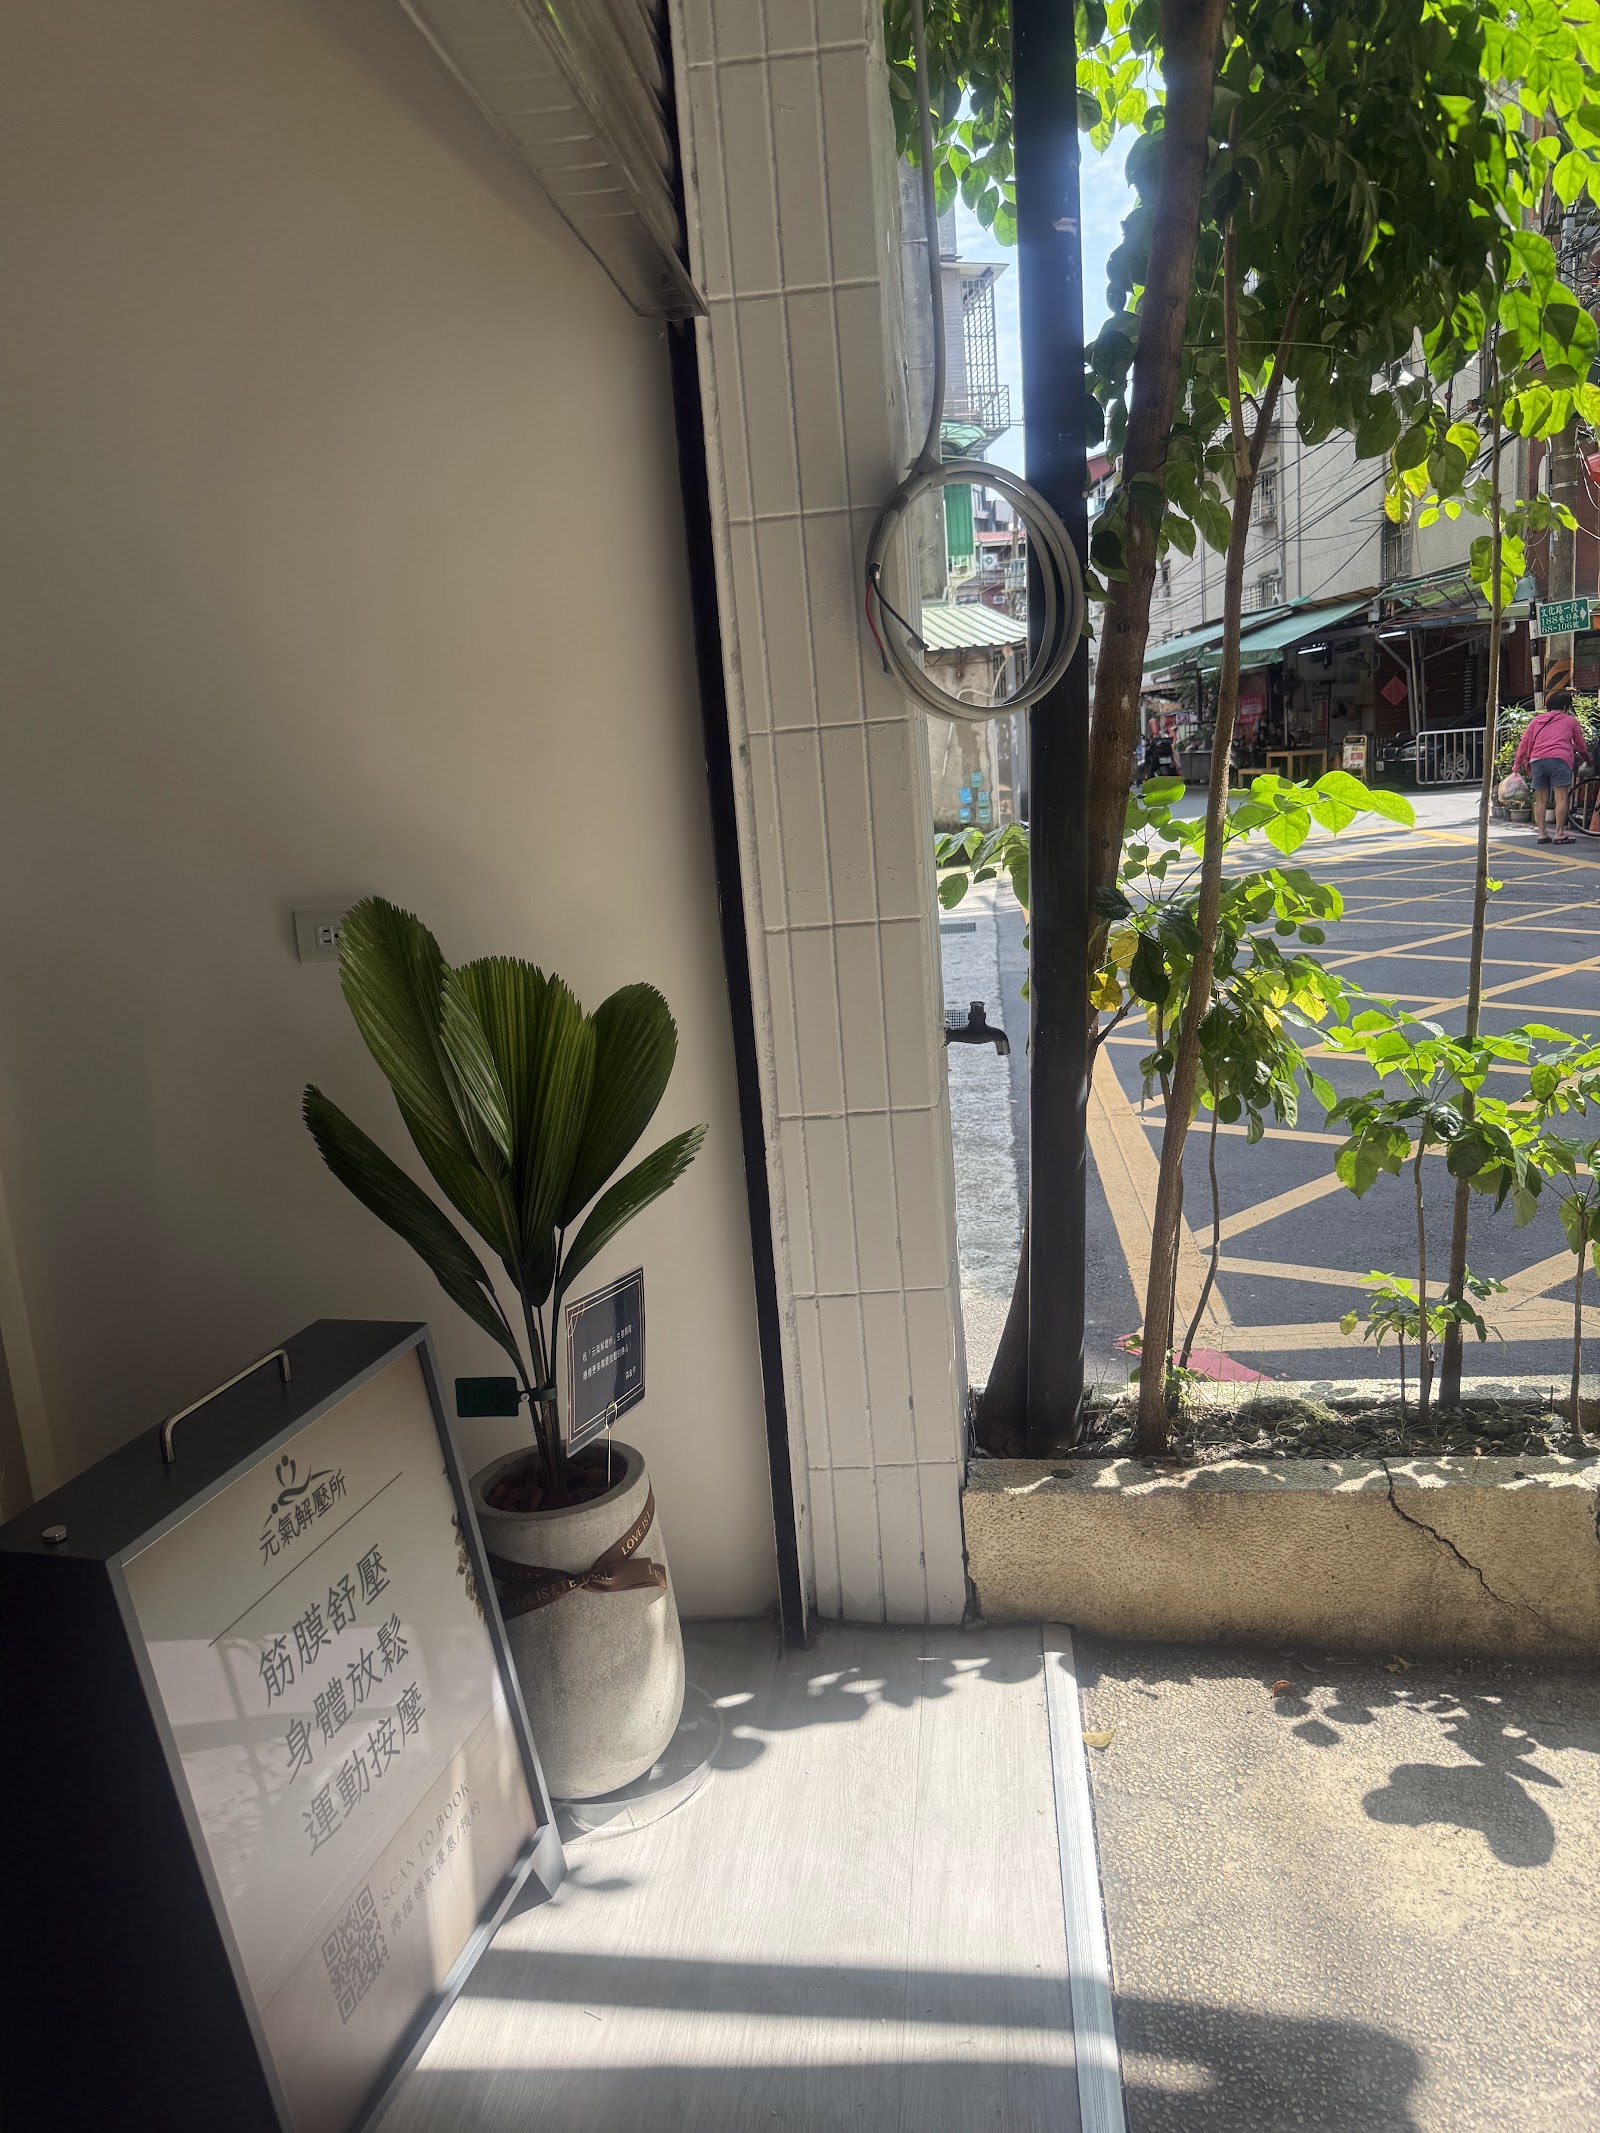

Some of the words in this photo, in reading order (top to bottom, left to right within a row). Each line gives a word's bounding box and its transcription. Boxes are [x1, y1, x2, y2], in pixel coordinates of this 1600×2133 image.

[1541, 602, 1578, 617] 文化路一段
[1541, 612, 1579, 625] 188巷9弄
[1541, 621, 1579, 633] 68~106號
[259, 1468, 347, 1566] 元氣解壓所
[620, 1525, 644, 1556] LOVE
[641, 1514, 650, 1531] IS
[259, 1543, 391, 1708] 筋膜舒壓
[536, 1587, 550, 1601] IS
[284, 1612, 411, 1785] 身體放鬆
[302, 1681, 427, 1857] 運動按摩
[381, 1853, 417, 1908] SCAN
[416, 1829, 434, 1857] TO
[435, 1780, 470, 1831] BOOK
